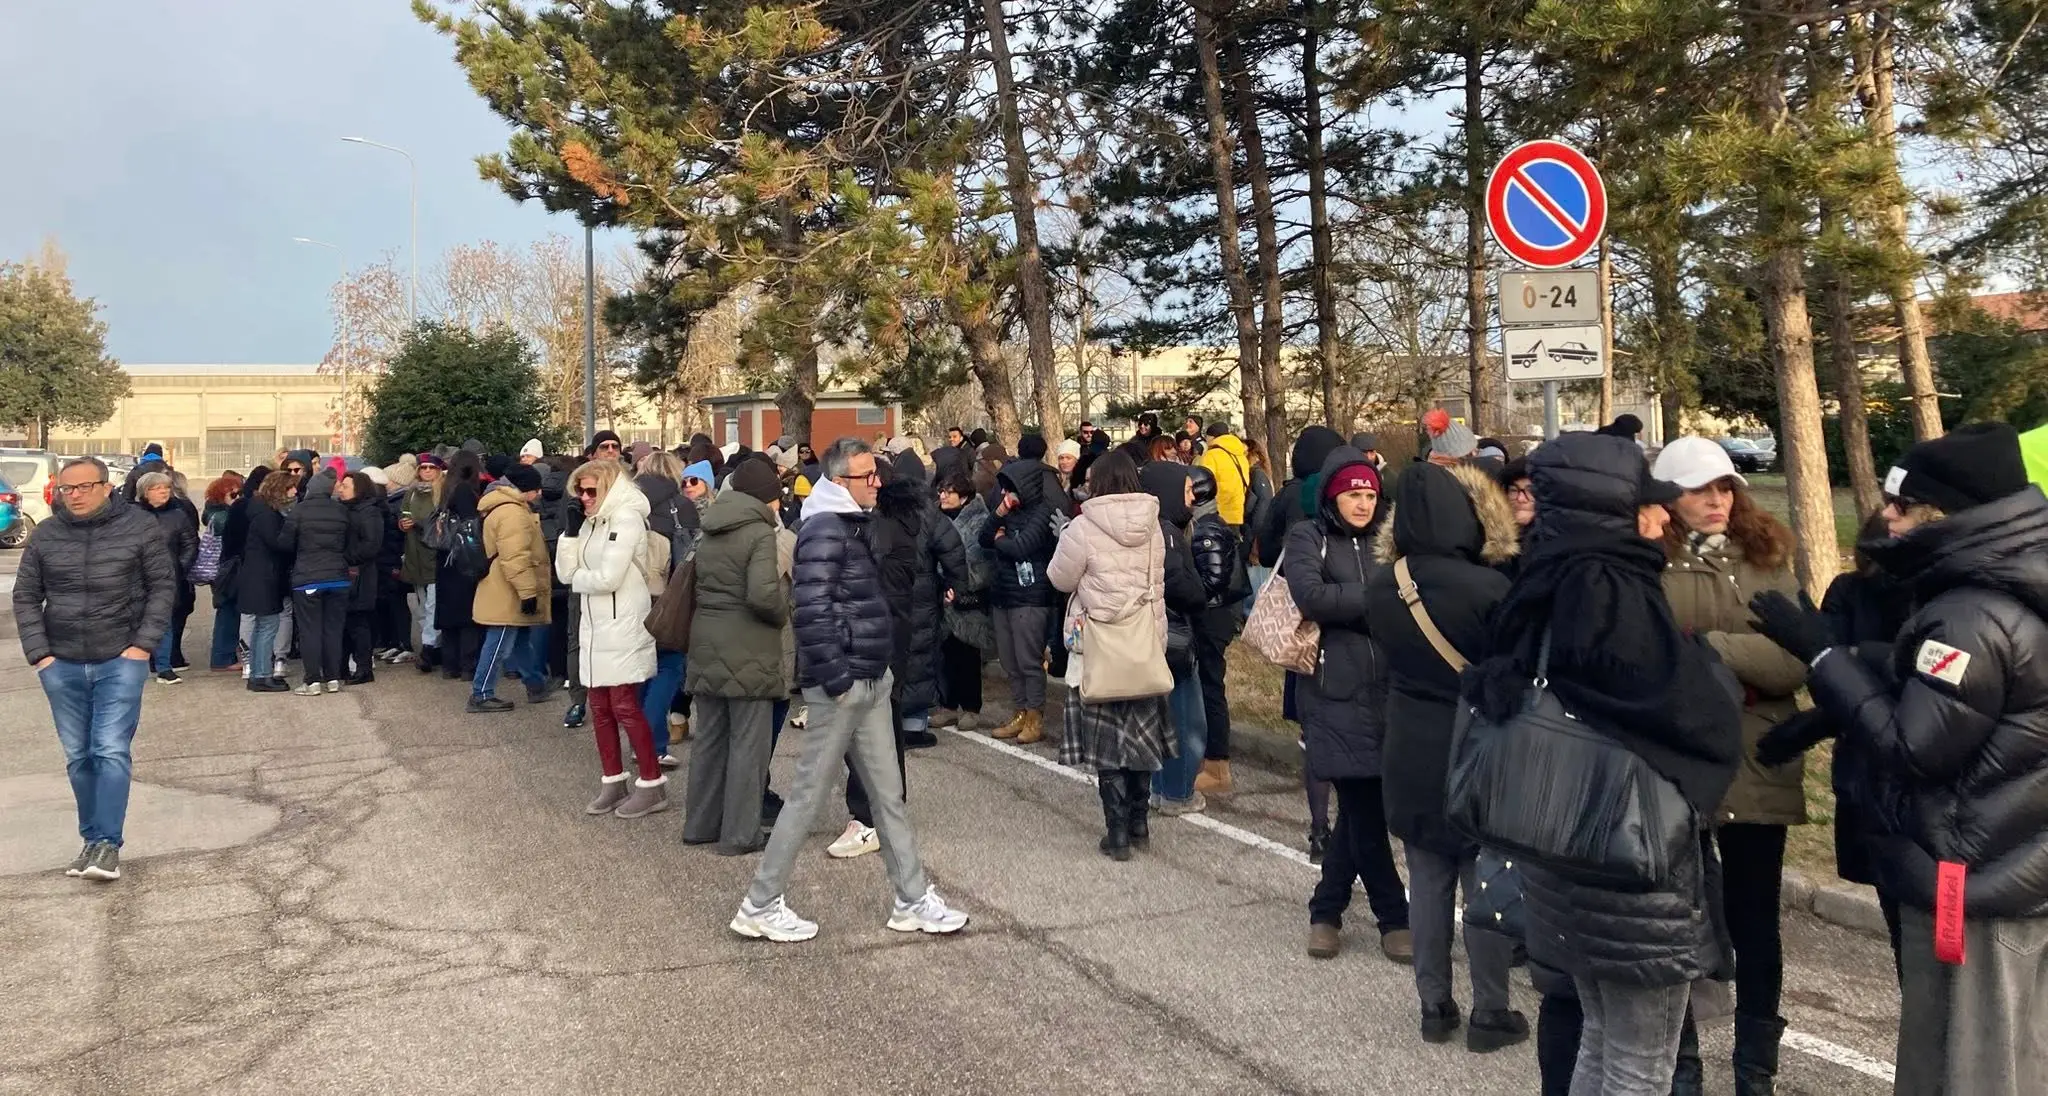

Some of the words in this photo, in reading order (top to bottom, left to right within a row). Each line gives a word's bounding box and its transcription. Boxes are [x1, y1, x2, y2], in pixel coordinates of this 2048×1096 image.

[1523, 285, 1577, 308] 0-24
[1351, 479, 1372, 487] FILA
[1928, 648, 1953, 662] afte
